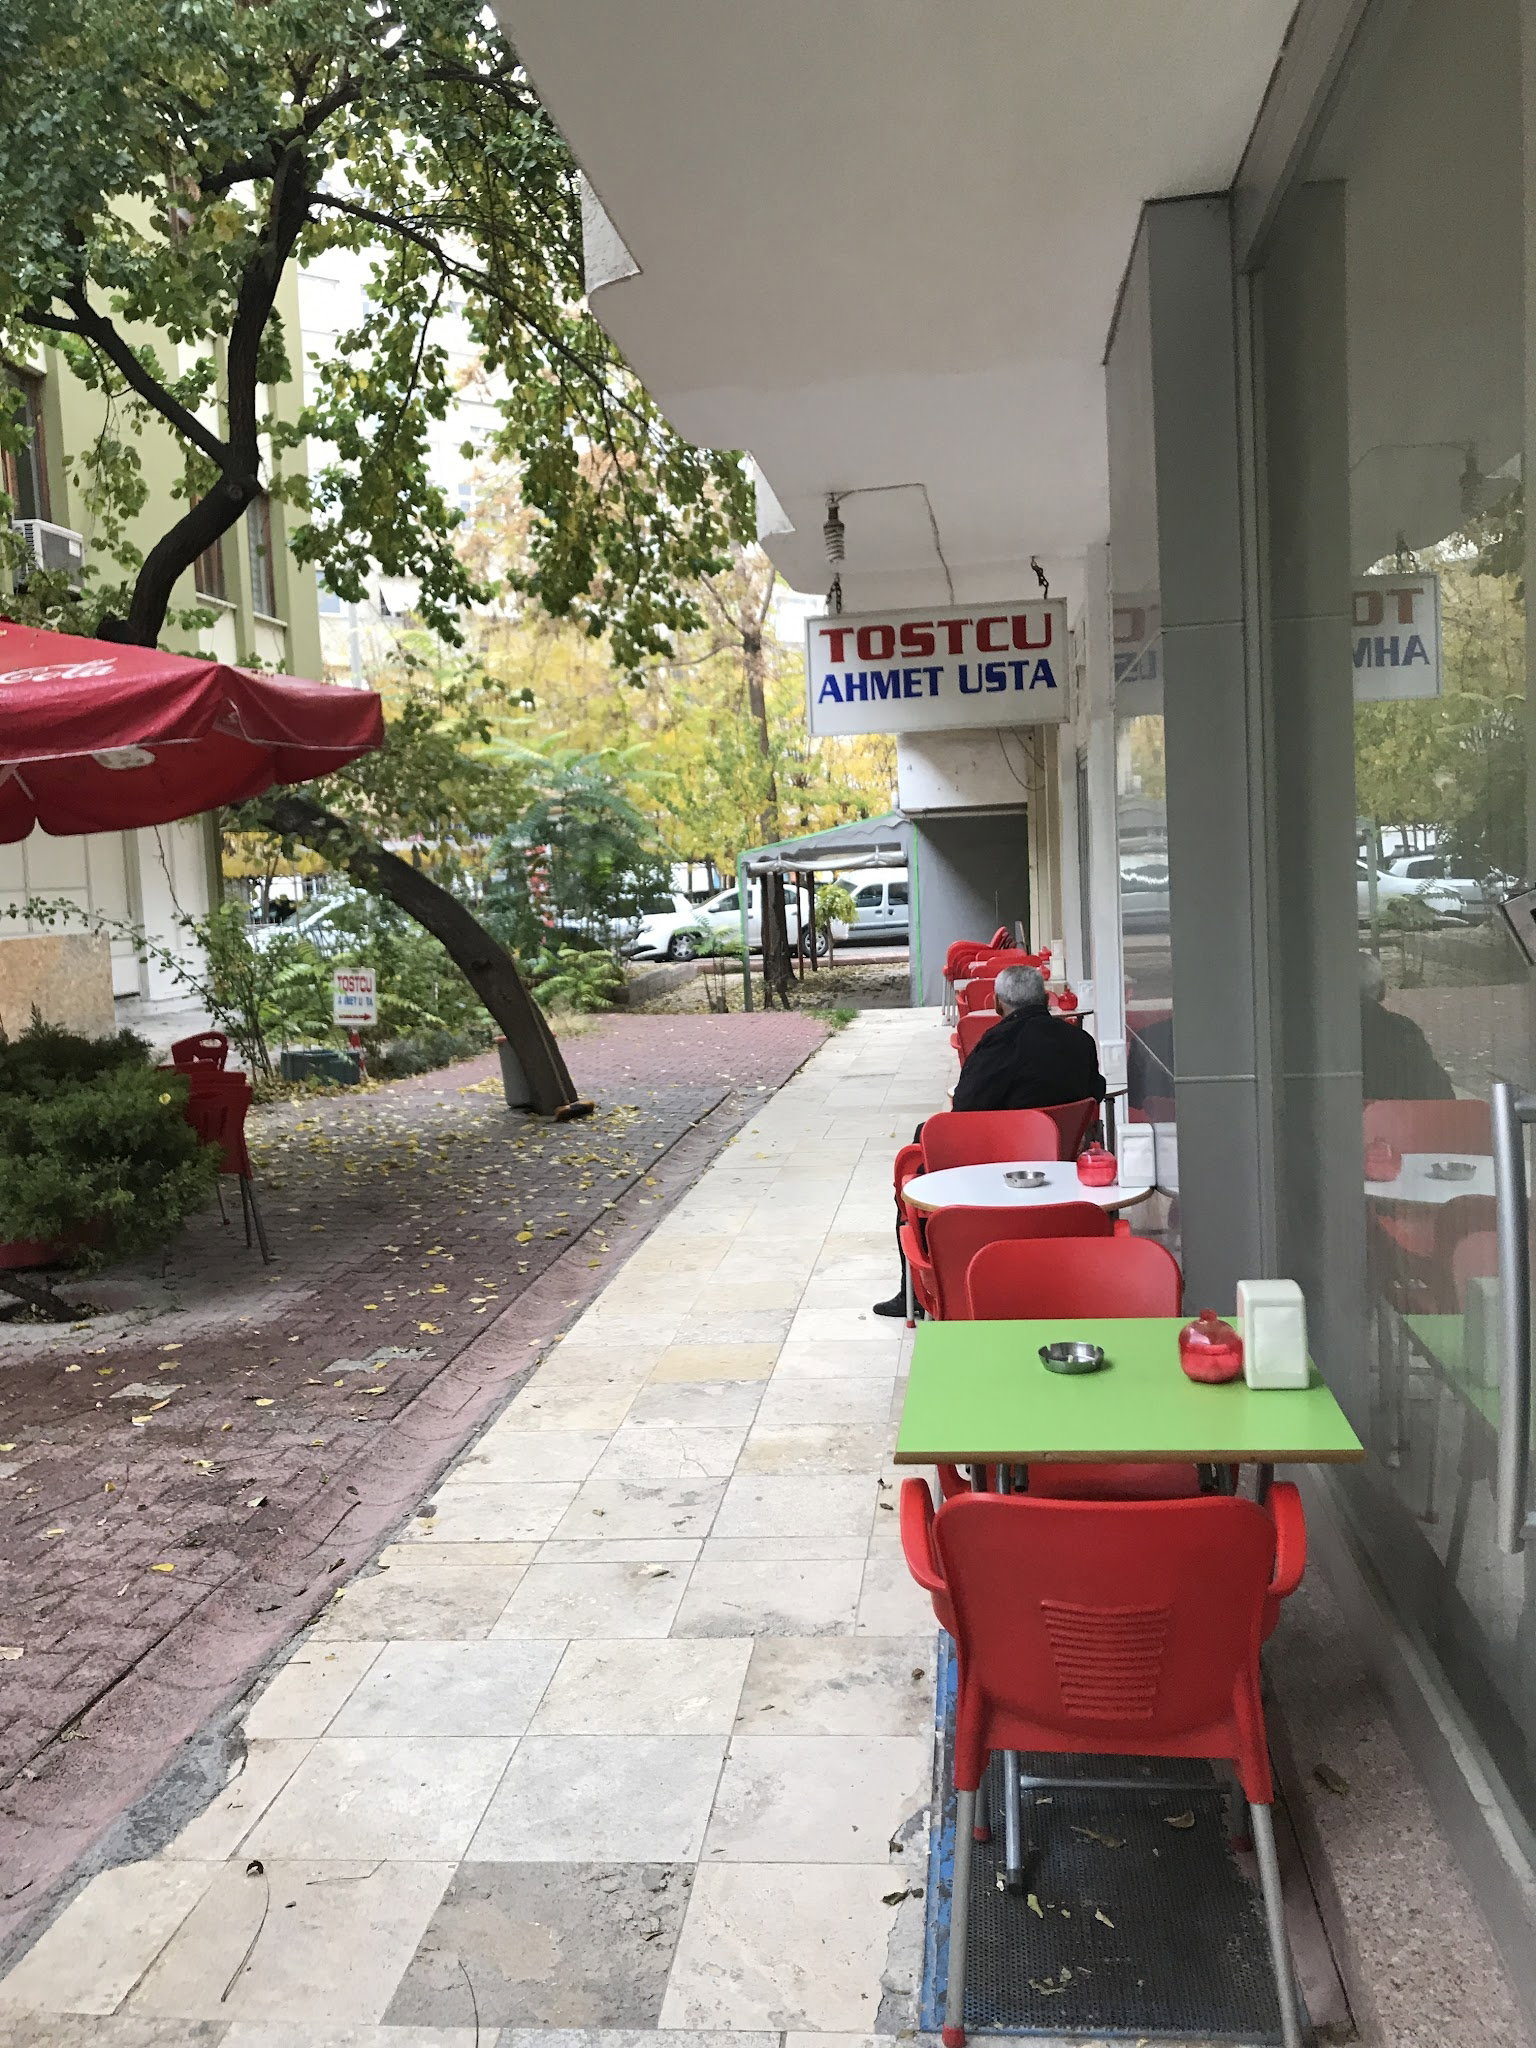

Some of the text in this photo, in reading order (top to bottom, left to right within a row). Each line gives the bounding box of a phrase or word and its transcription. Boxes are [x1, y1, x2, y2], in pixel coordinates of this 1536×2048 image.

[819, 613, 1053, 663] TOSTCU
[818, 658, 1058, 704] AHMET USTA
